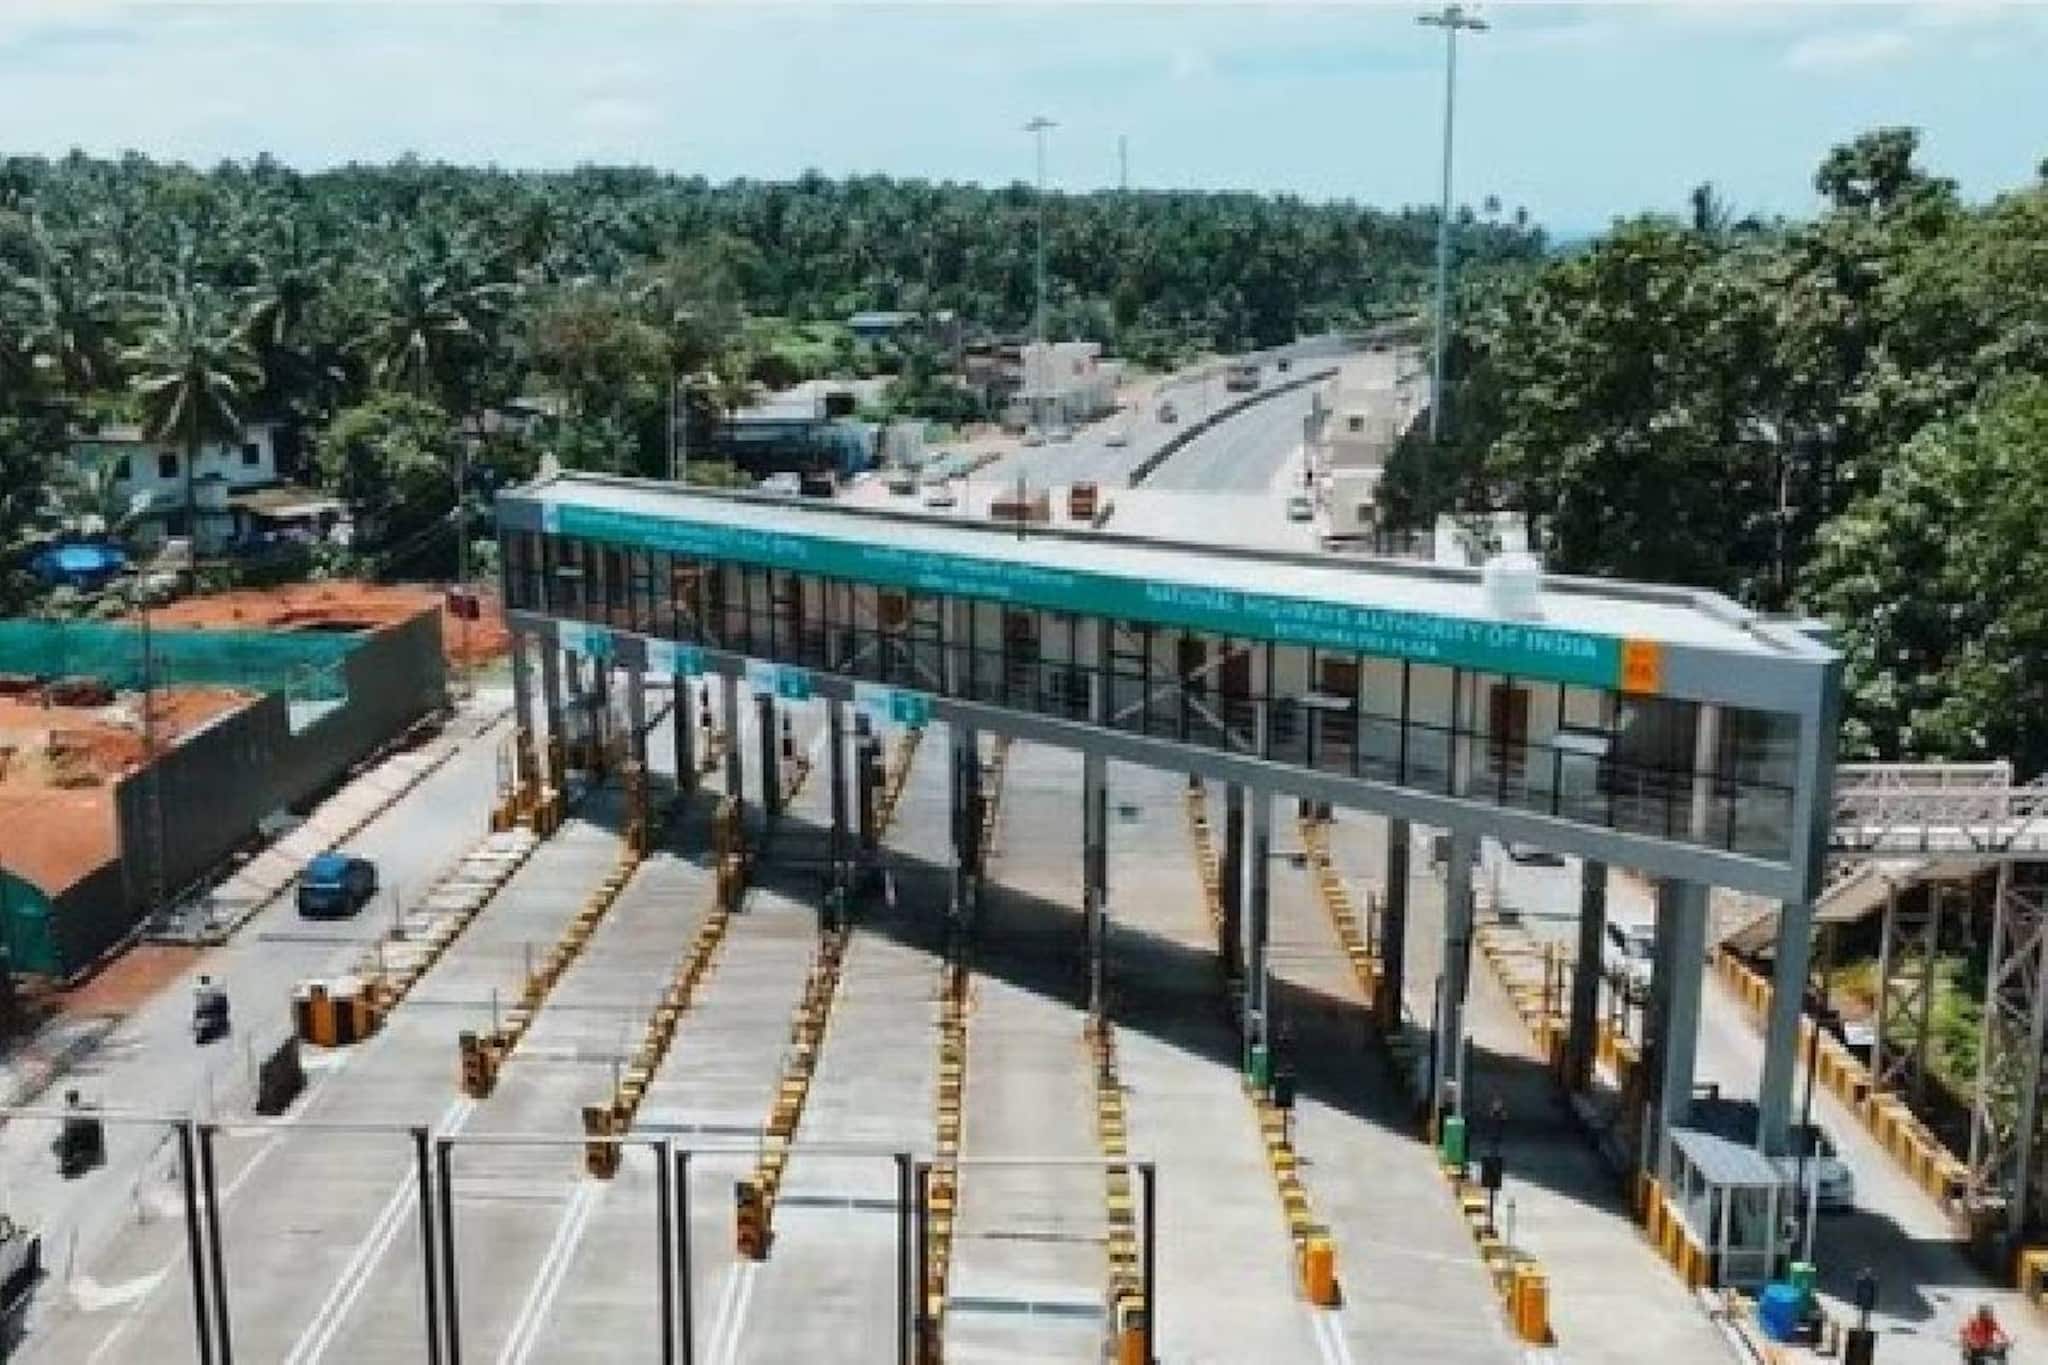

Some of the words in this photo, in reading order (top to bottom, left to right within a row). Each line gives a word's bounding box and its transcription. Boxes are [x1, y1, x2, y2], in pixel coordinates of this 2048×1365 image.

[1145, 583, 1235, 612] NATIONAL
[1355, 608, 1480, 642] AUTHORITY
[1488, 625, 1518, 648] OF
[1525, 630, 1597, 658] INDIA
